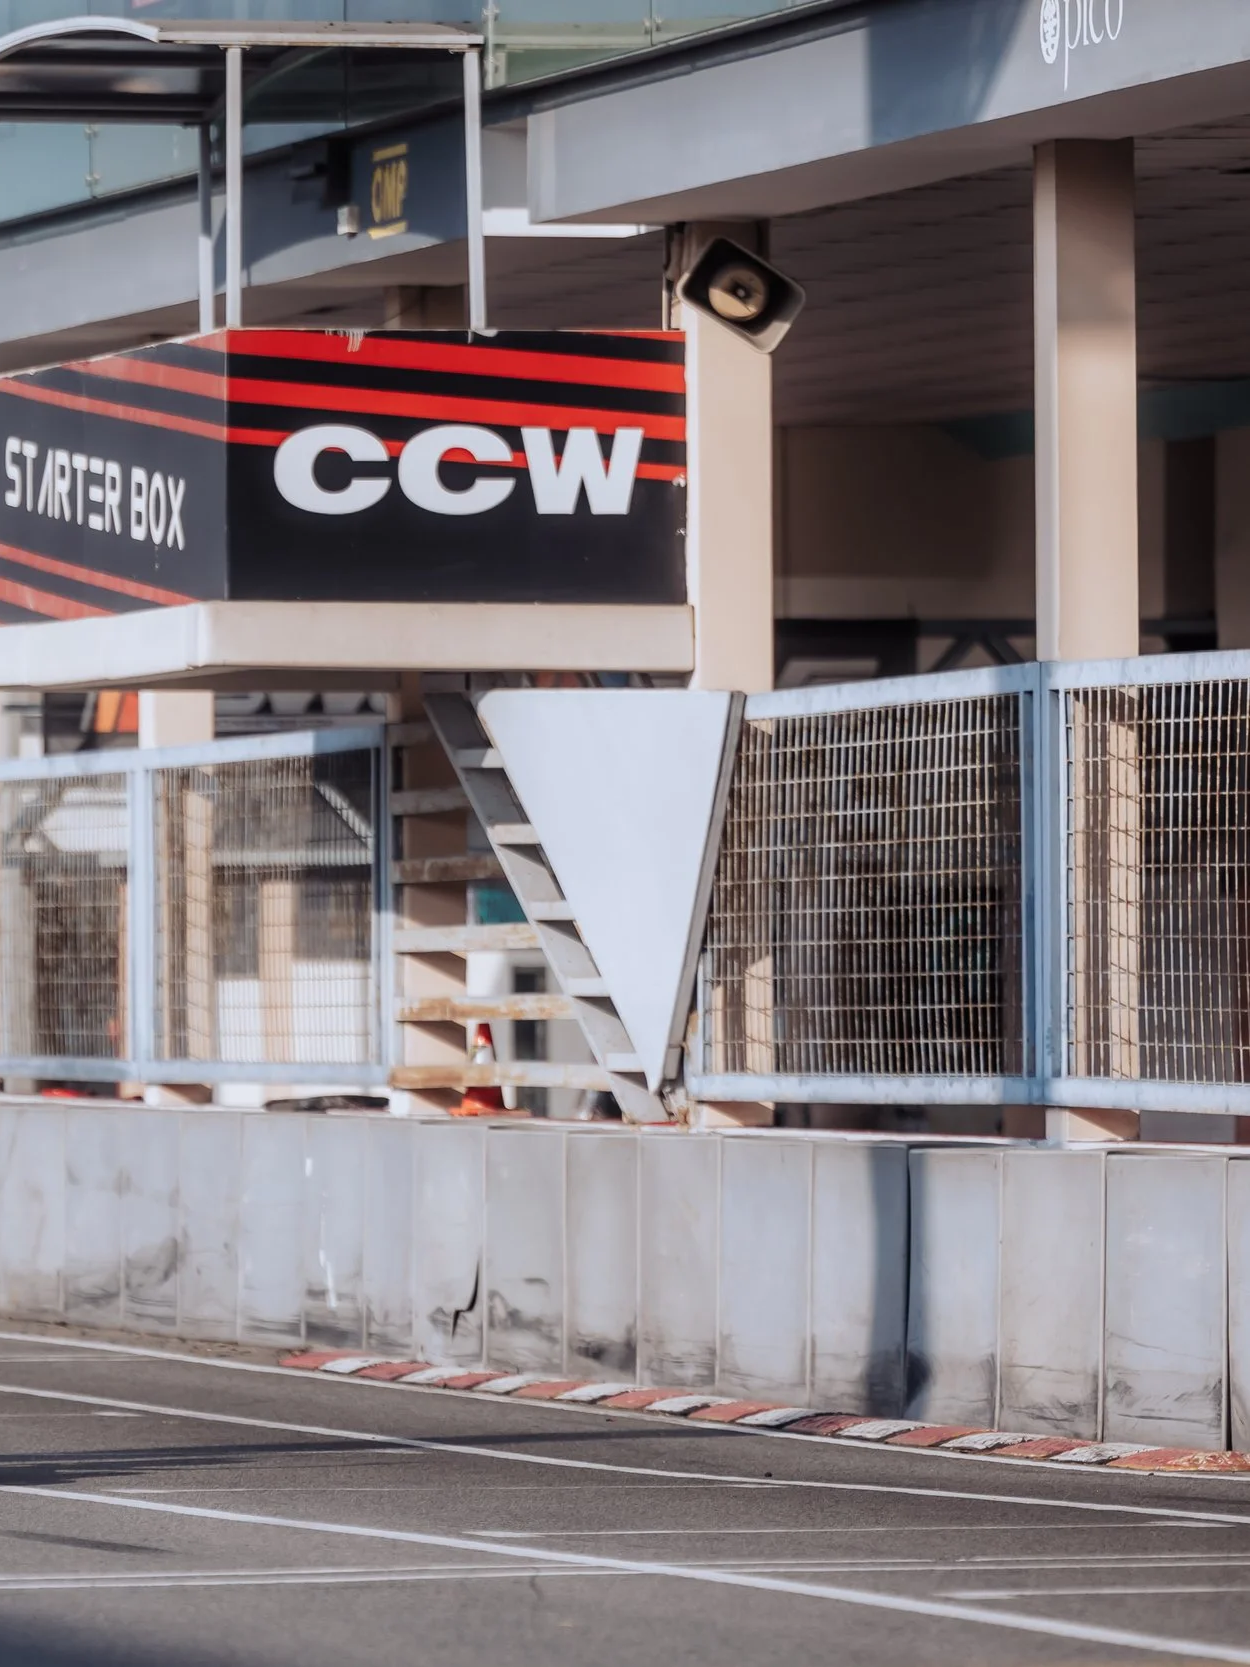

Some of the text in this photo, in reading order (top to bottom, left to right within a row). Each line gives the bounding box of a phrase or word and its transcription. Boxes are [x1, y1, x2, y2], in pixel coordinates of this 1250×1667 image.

[4, 436, 186, 551] STARTER BOX
[273, 423, 644, 515] CCW
